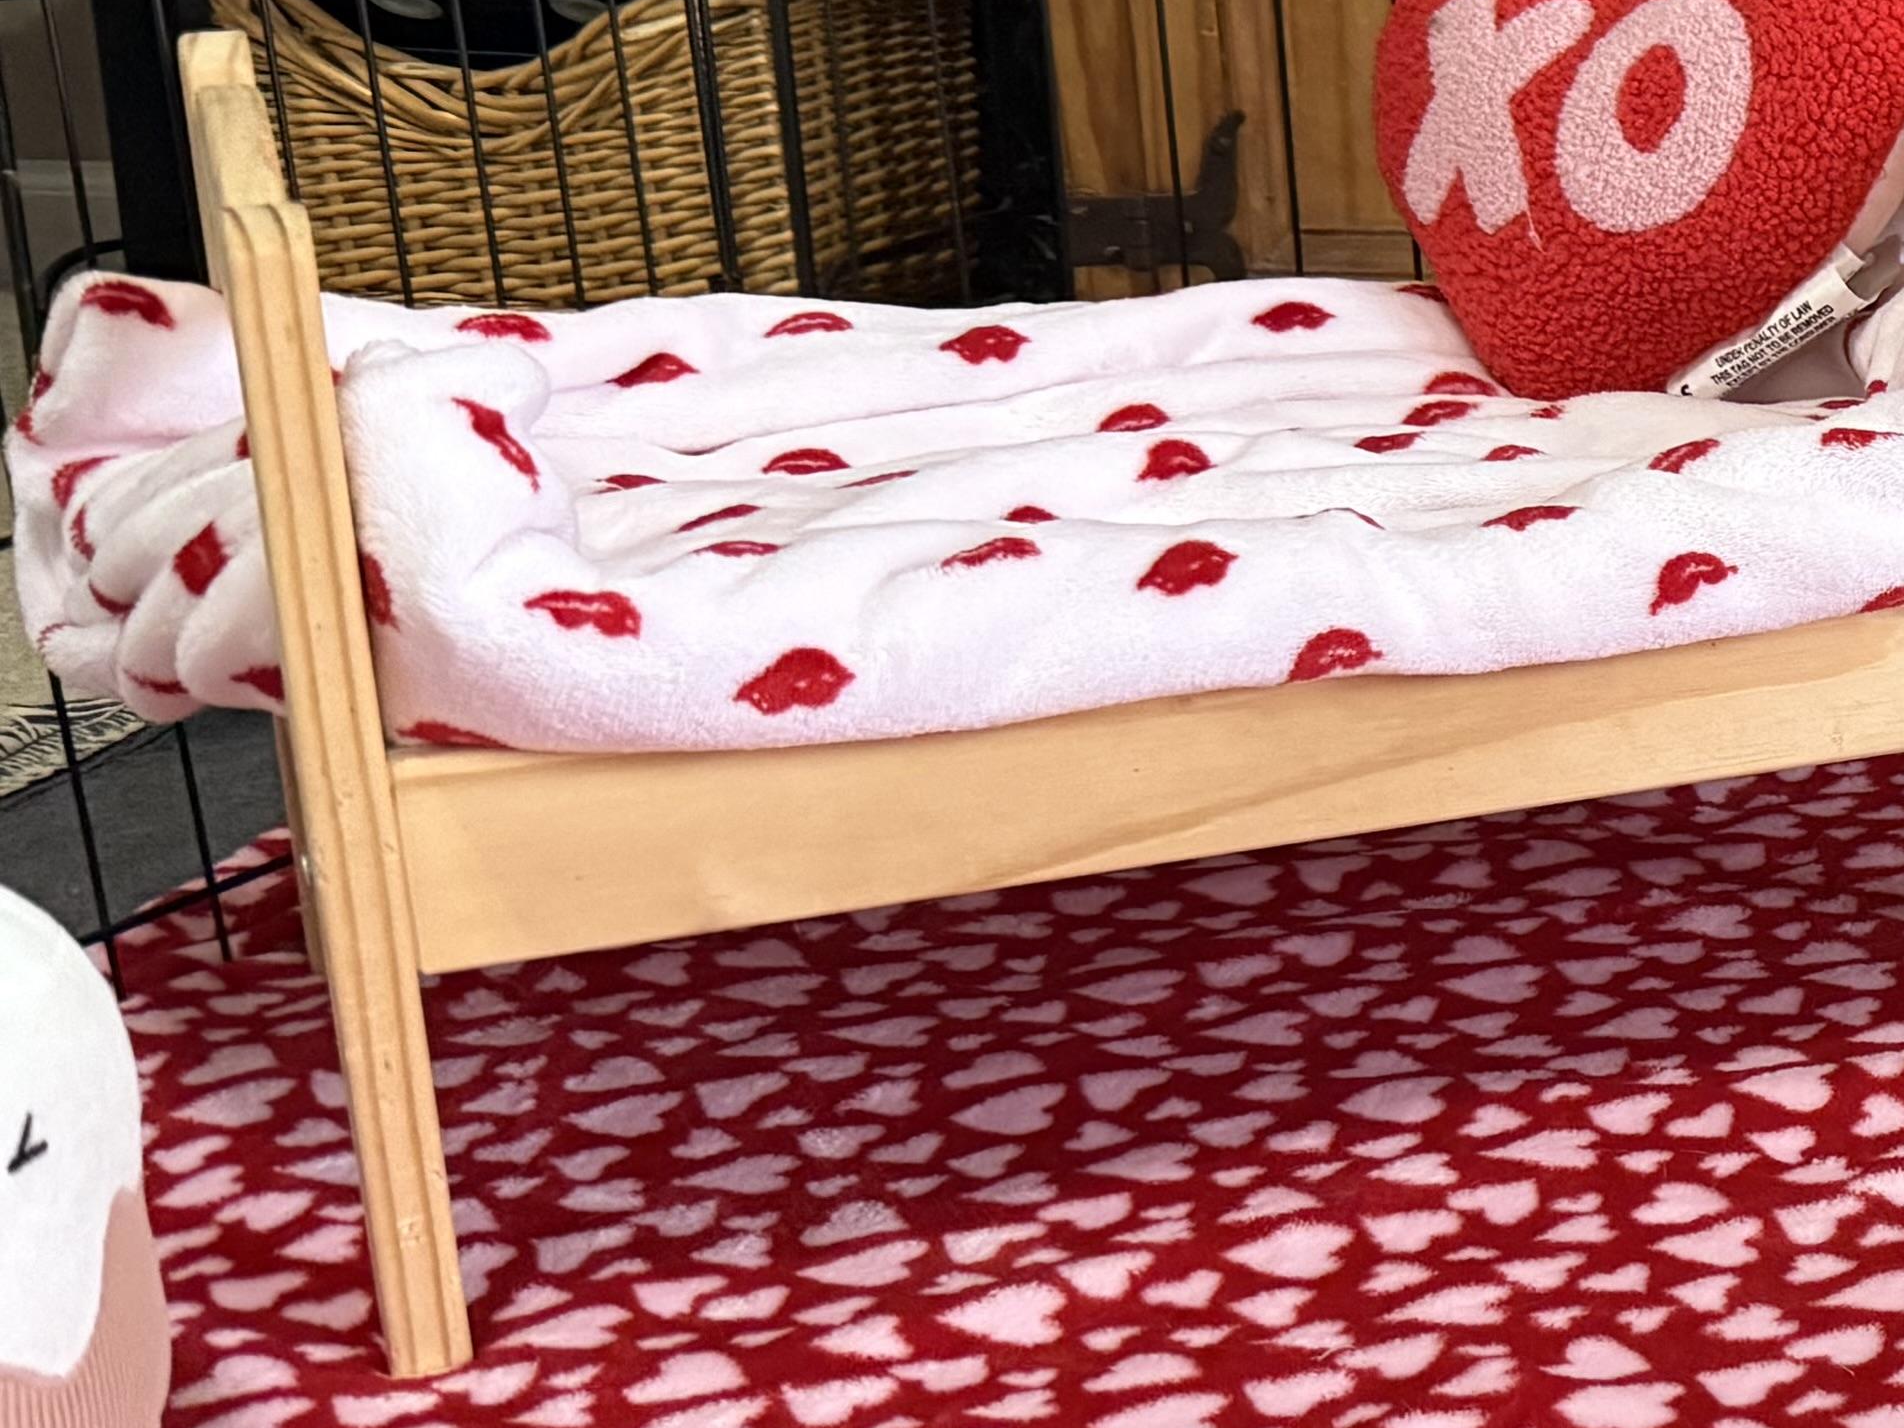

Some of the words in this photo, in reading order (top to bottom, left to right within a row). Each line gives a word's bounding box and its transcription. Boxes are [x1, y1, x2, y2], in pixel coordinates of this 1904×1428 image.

[1710, 368, 1732, 386] THIS
[1731, 359, 1751, 375] TAG
[1749, 348, 1769, 365] NOT
[1765, 339, 1781, 353] TO
[1780, 330, 1796, 346] BE
[1793, 304, 1834, 336] REMOVED
[1714, 346, 1744, 368] UNDER
[1778, 315, 1792, 331] OF
[1790, 300, 1813, 322] LAW
